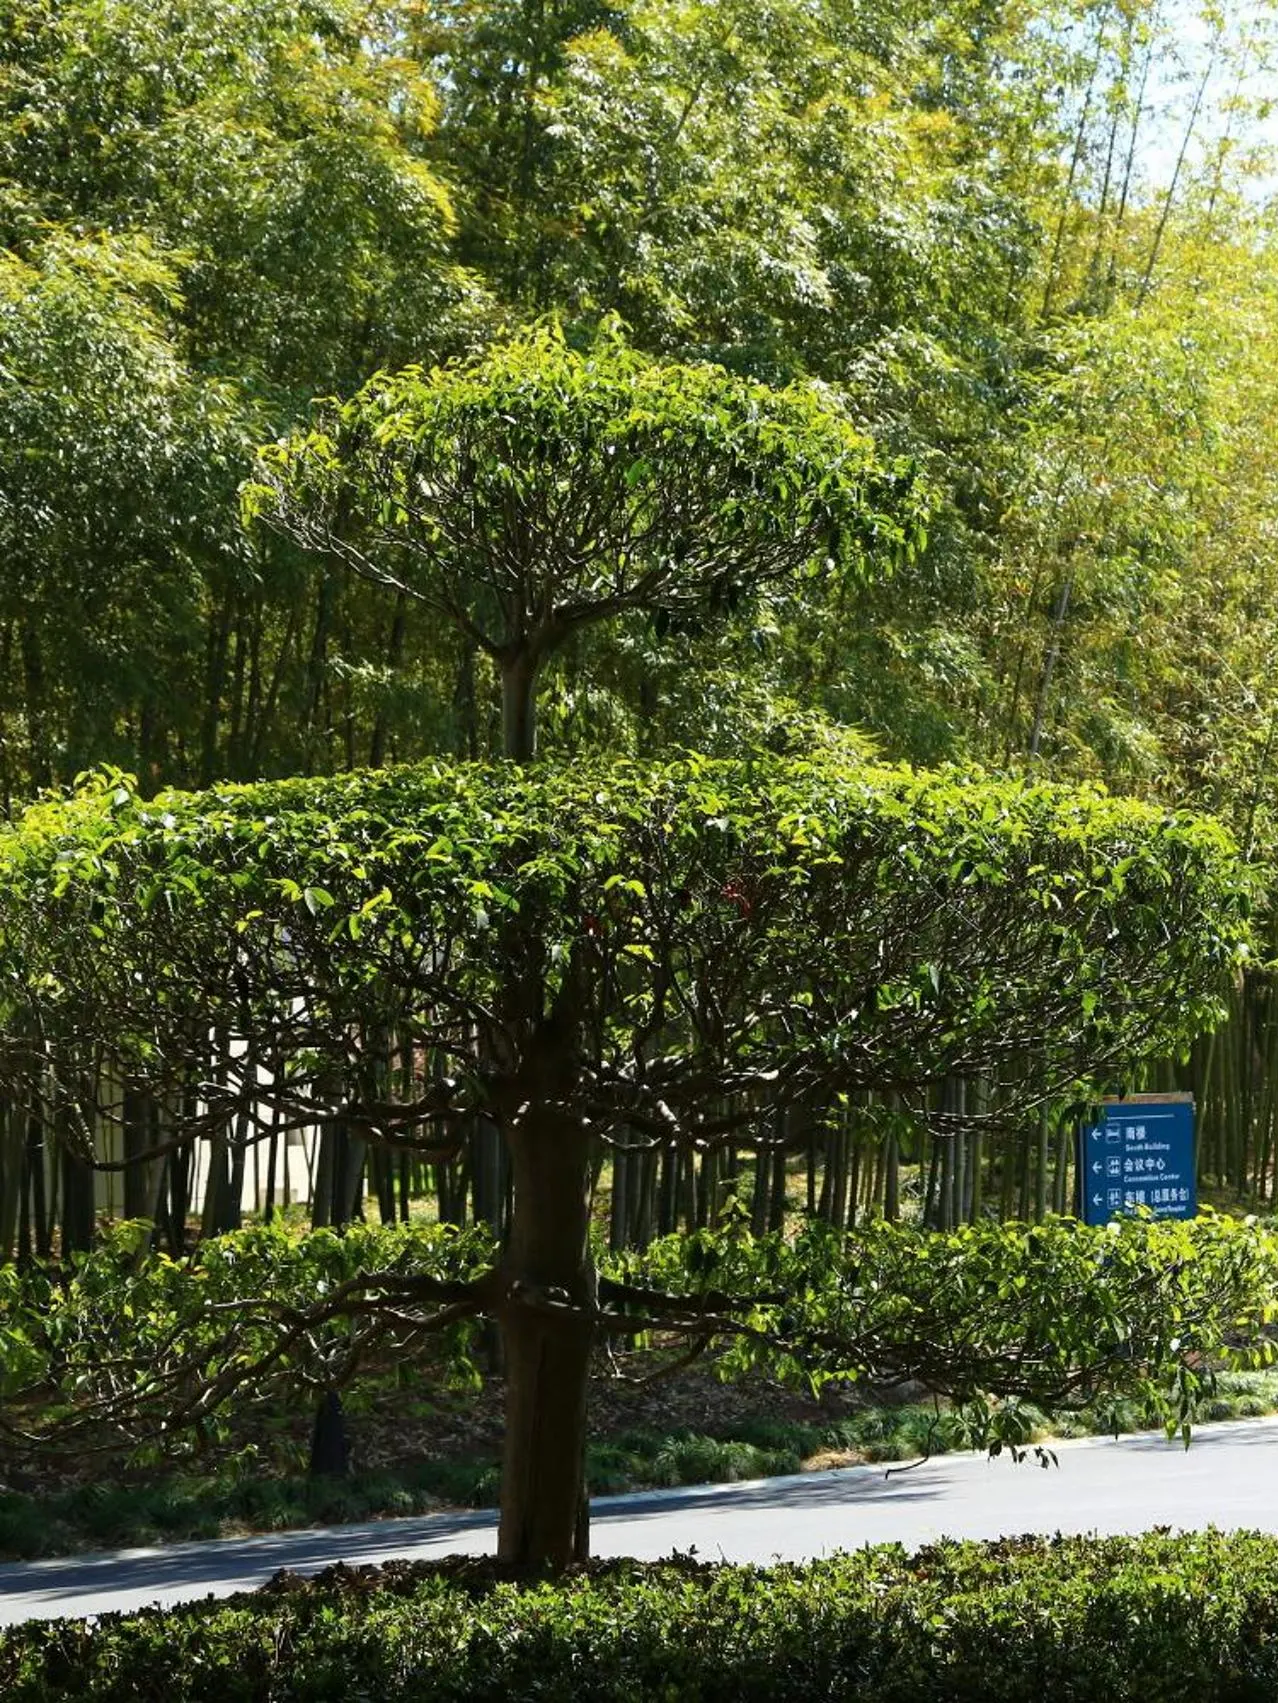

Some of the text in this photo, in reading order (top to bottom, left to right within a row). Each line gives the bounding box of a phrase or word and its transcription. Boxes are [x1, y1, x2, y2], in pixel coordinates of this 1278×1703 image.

[1144, 1142, 1170, 1151] Building
[1123, 1158, 1166, 1172] 会议中心
